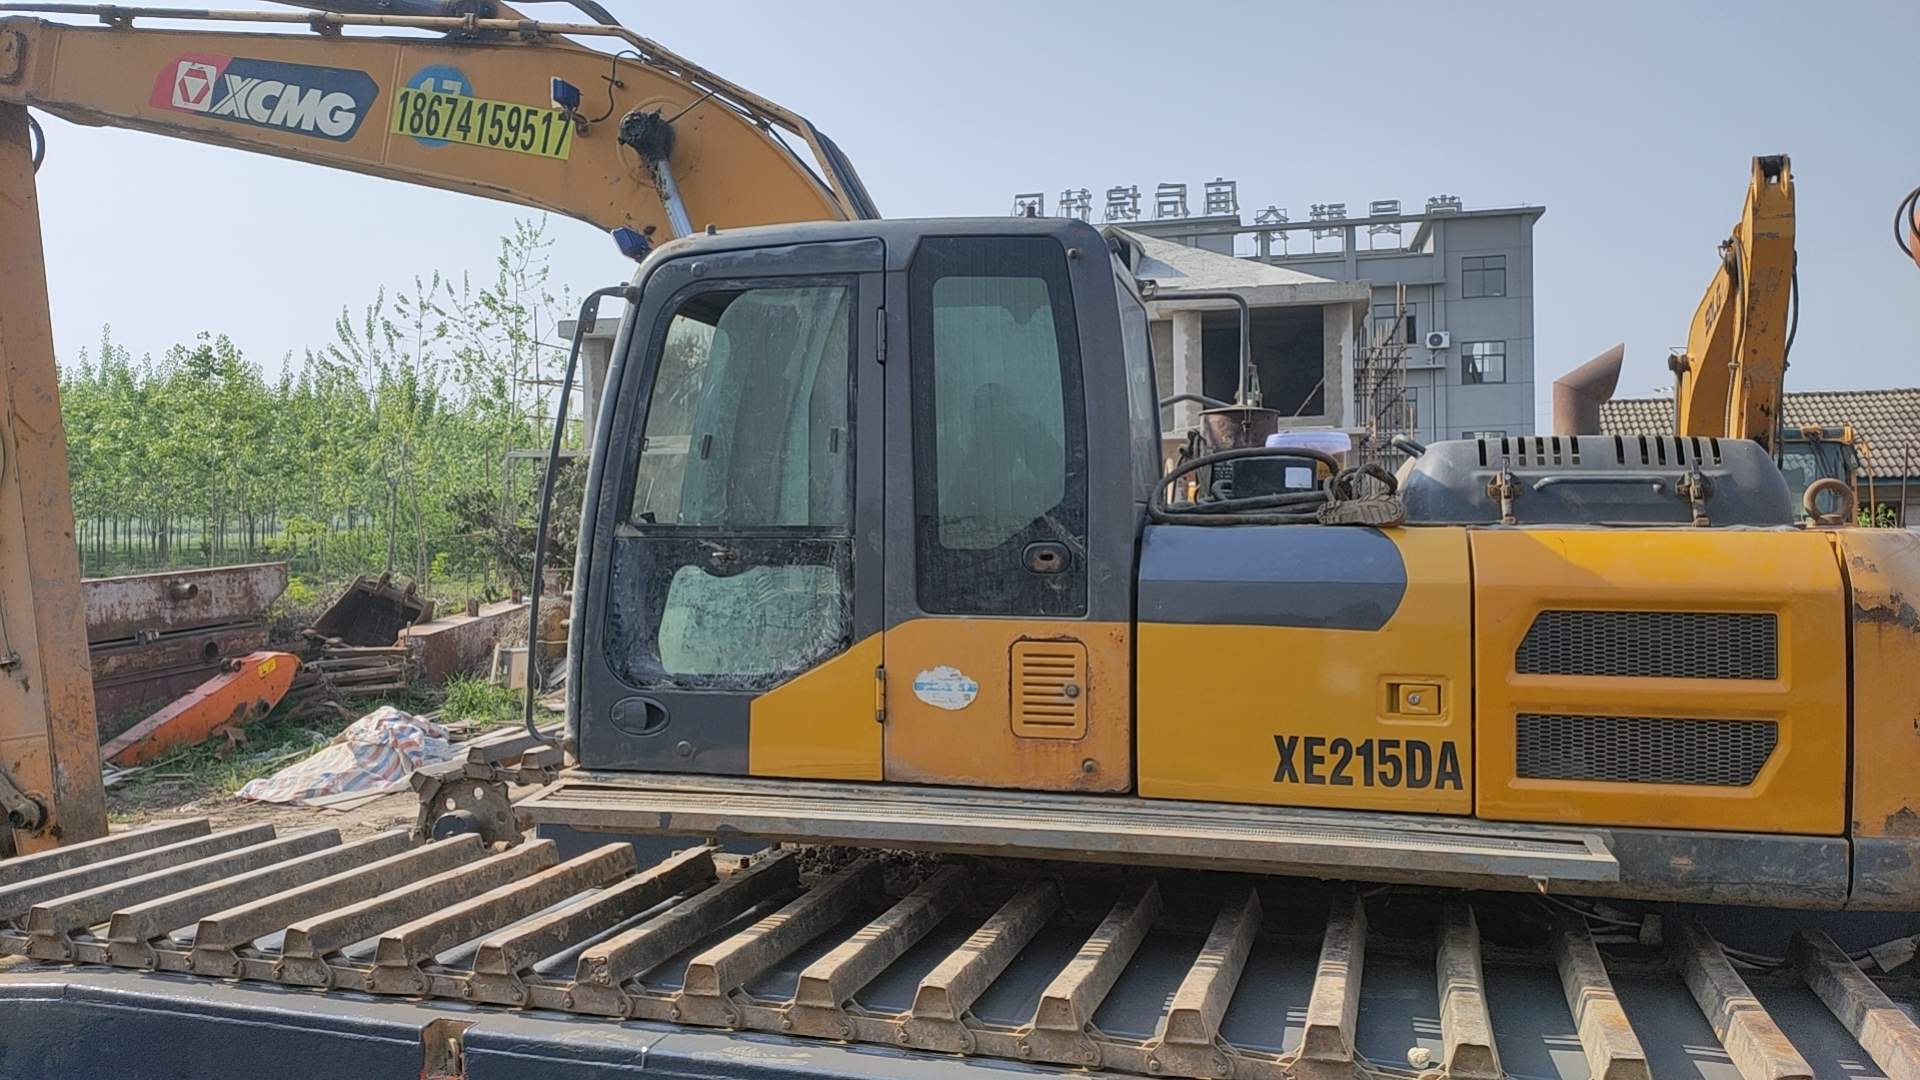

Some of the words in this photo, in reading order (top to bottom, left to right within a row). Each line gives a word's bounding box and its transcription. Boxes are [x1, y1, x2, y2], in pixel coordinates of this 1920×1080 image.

[209, 74, 357, 137] XCMG
[398, 90, 571, 156] 18674159517
[1273, 734, 1464, 790] XE215DA
